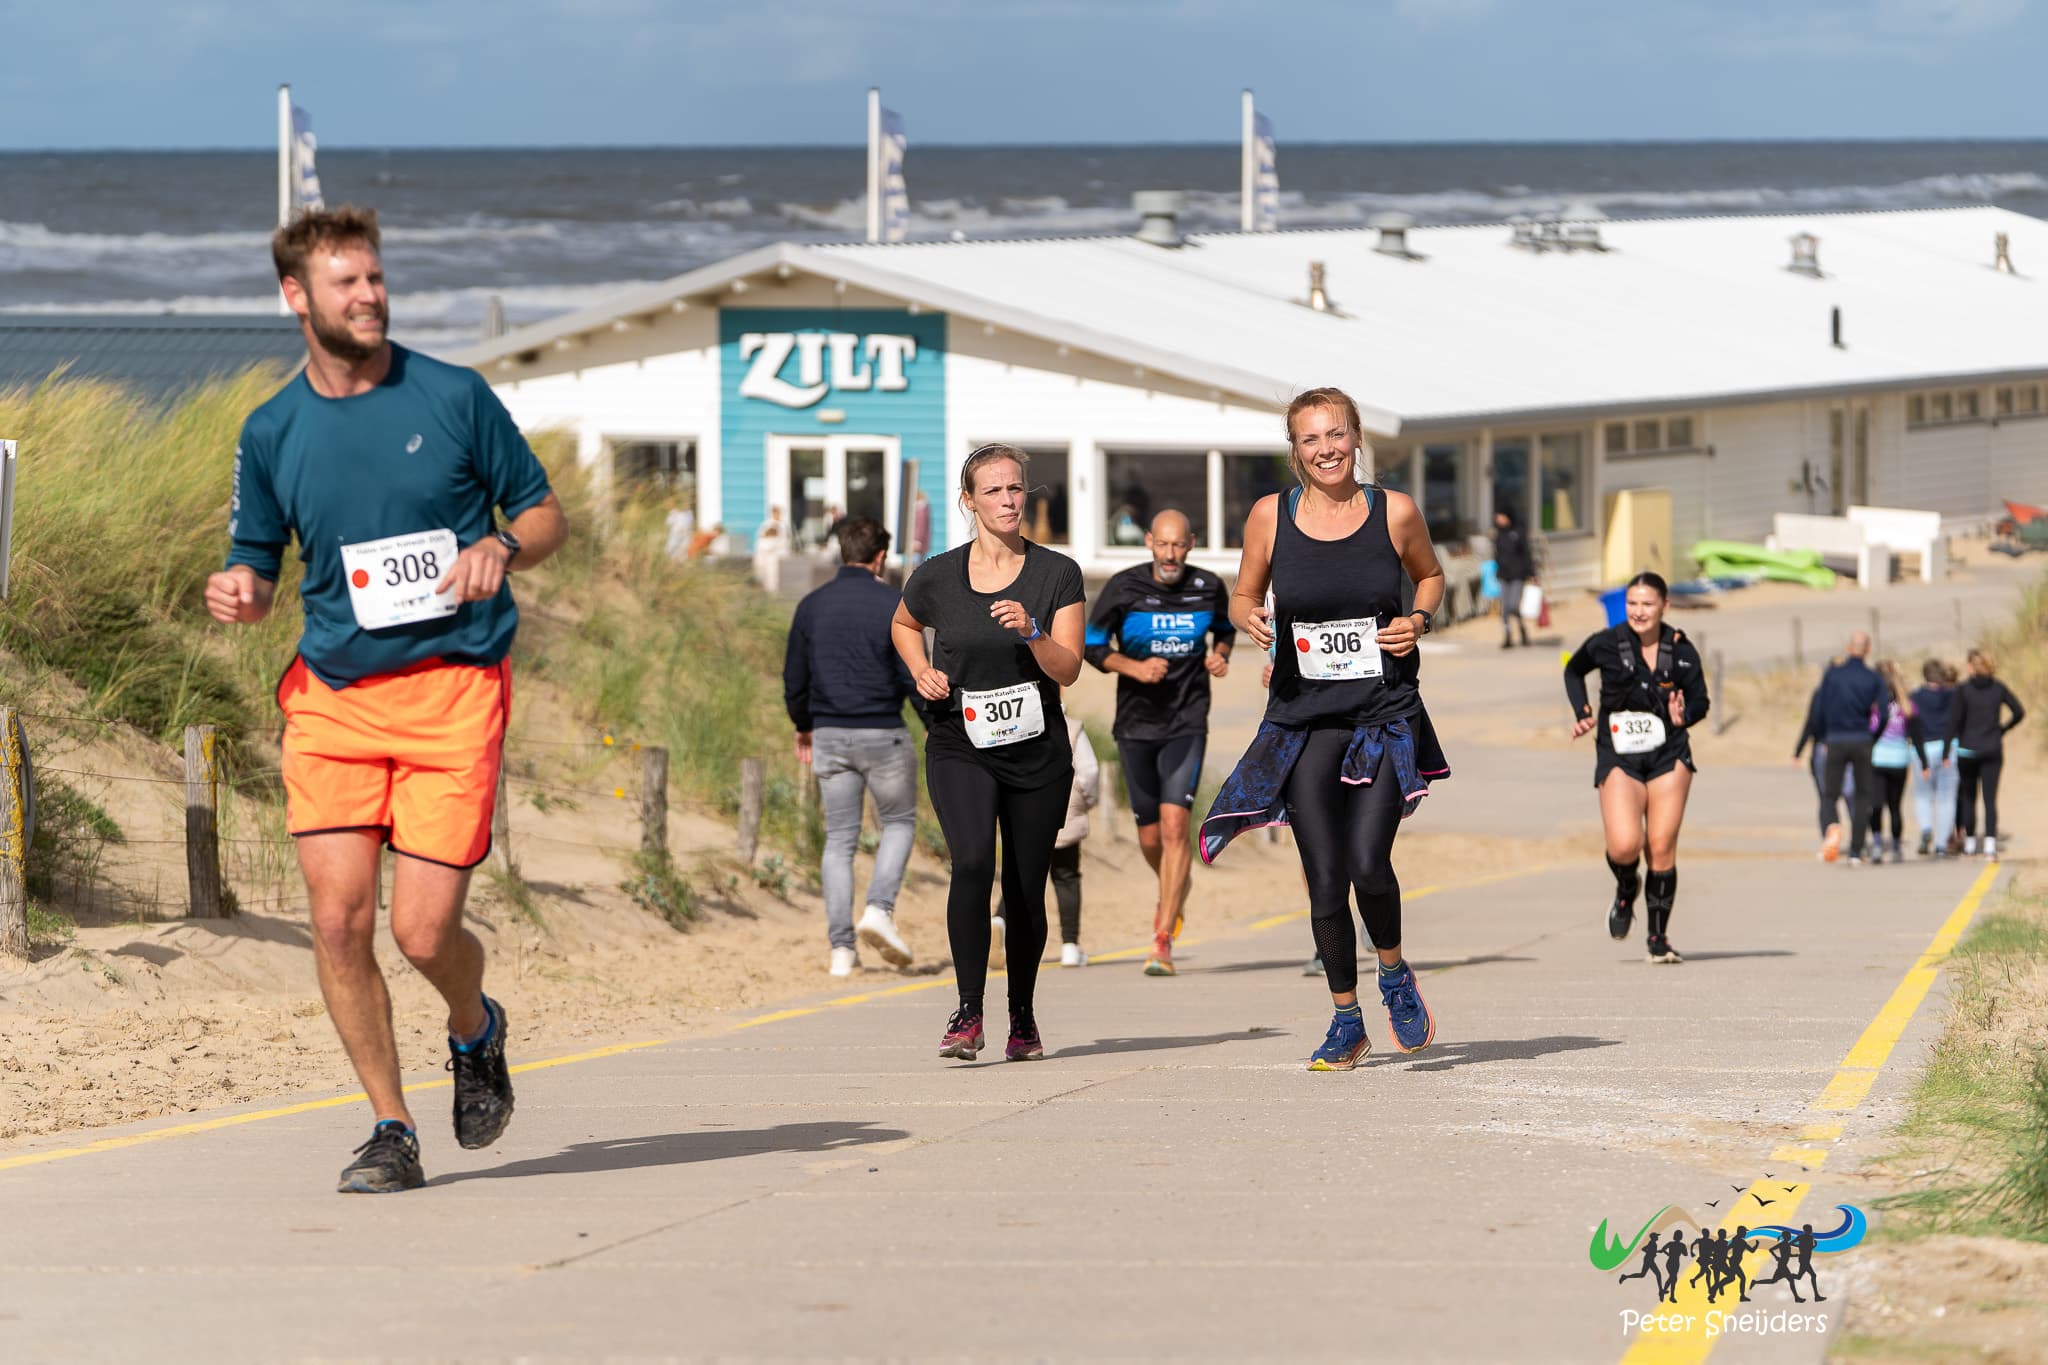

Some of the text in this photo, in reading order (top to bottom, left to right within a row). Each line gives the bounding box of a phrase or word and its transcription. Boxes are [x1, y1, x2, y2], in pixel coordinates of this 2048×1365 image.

[739, 332, 917, 409] ZILT
[383, 551, 439, 586] 308
[1319, 632, 1361, 654] 306
[1017, 685, 1031, 693] 2024
[984, 697, 1024, 723] 307
[1625, 719, 1652, 734] 332
